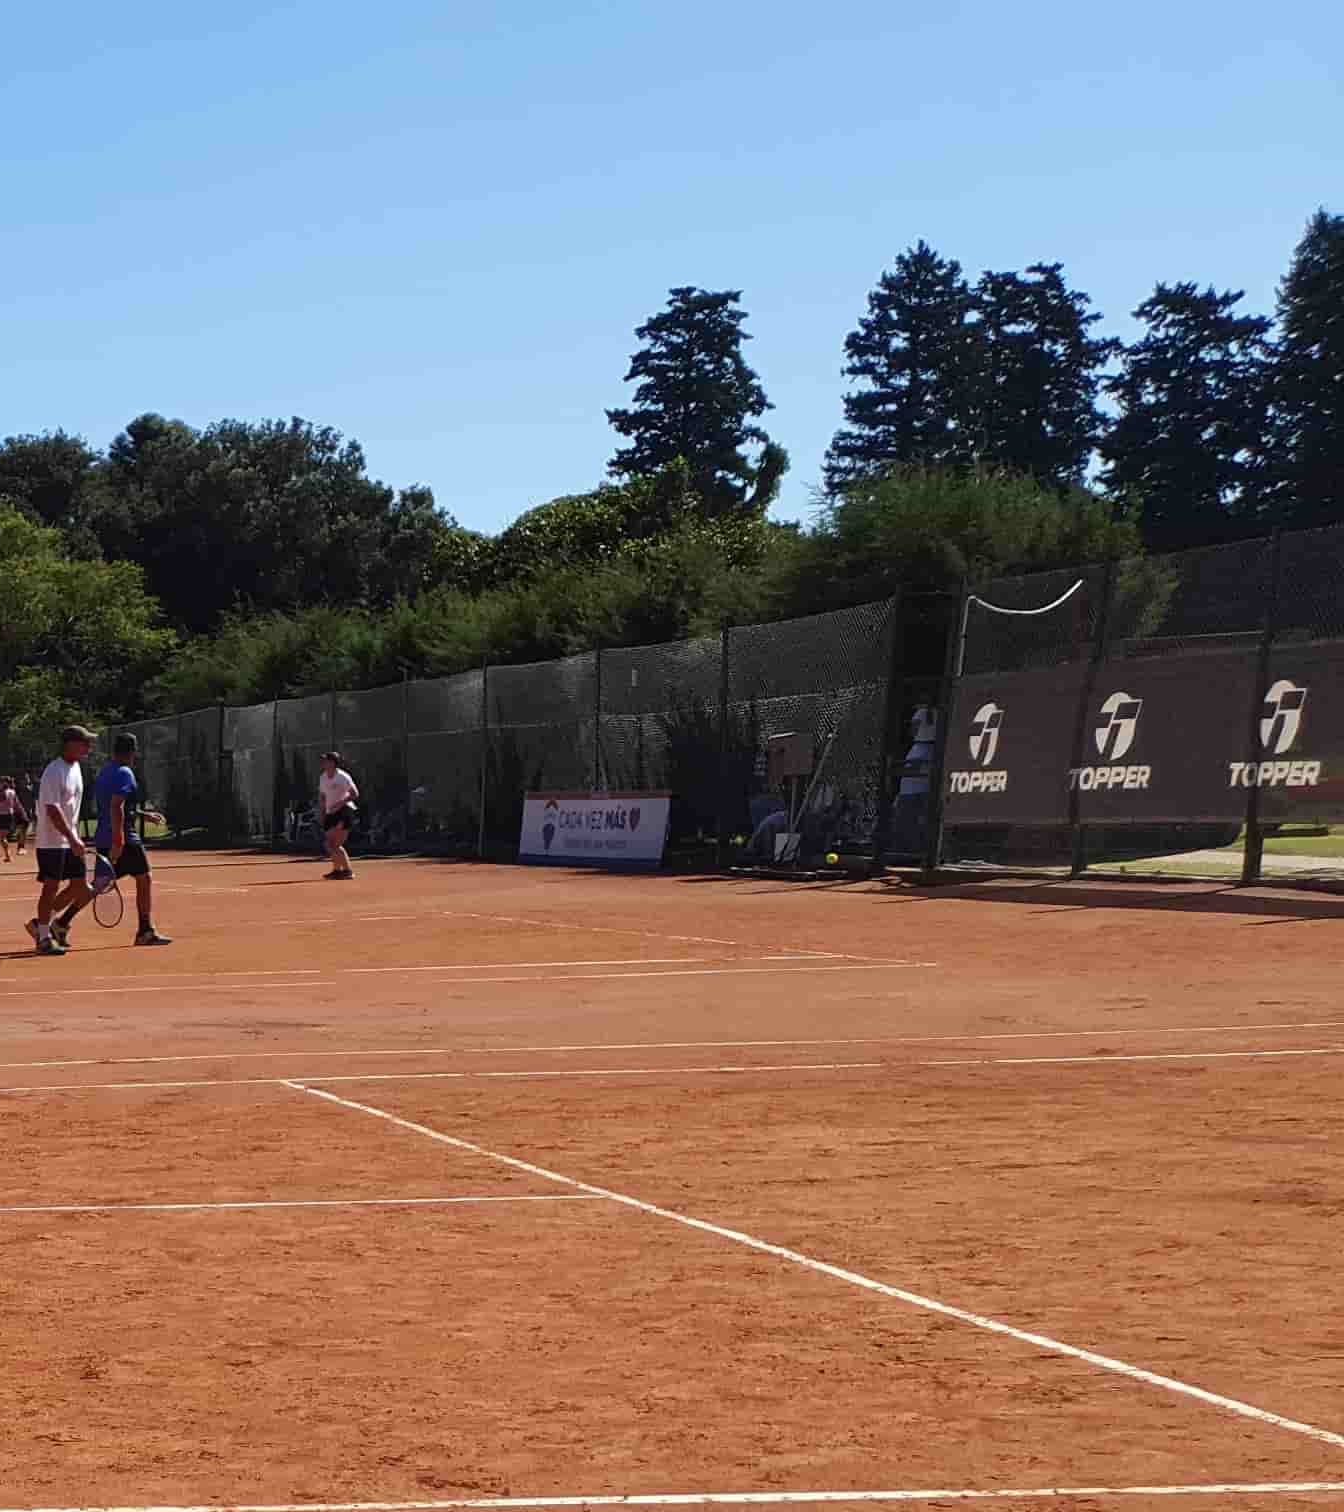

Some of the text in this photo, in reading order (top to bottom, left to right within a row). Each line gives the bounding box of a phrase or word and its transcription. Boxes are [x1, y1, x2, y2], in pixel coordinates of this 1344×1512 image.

[949, 770, 1008, 792] TOPPER
[1069, 765, 1152, 790] TOPPER
[1229, 760, 1320, 787] TOPPER
